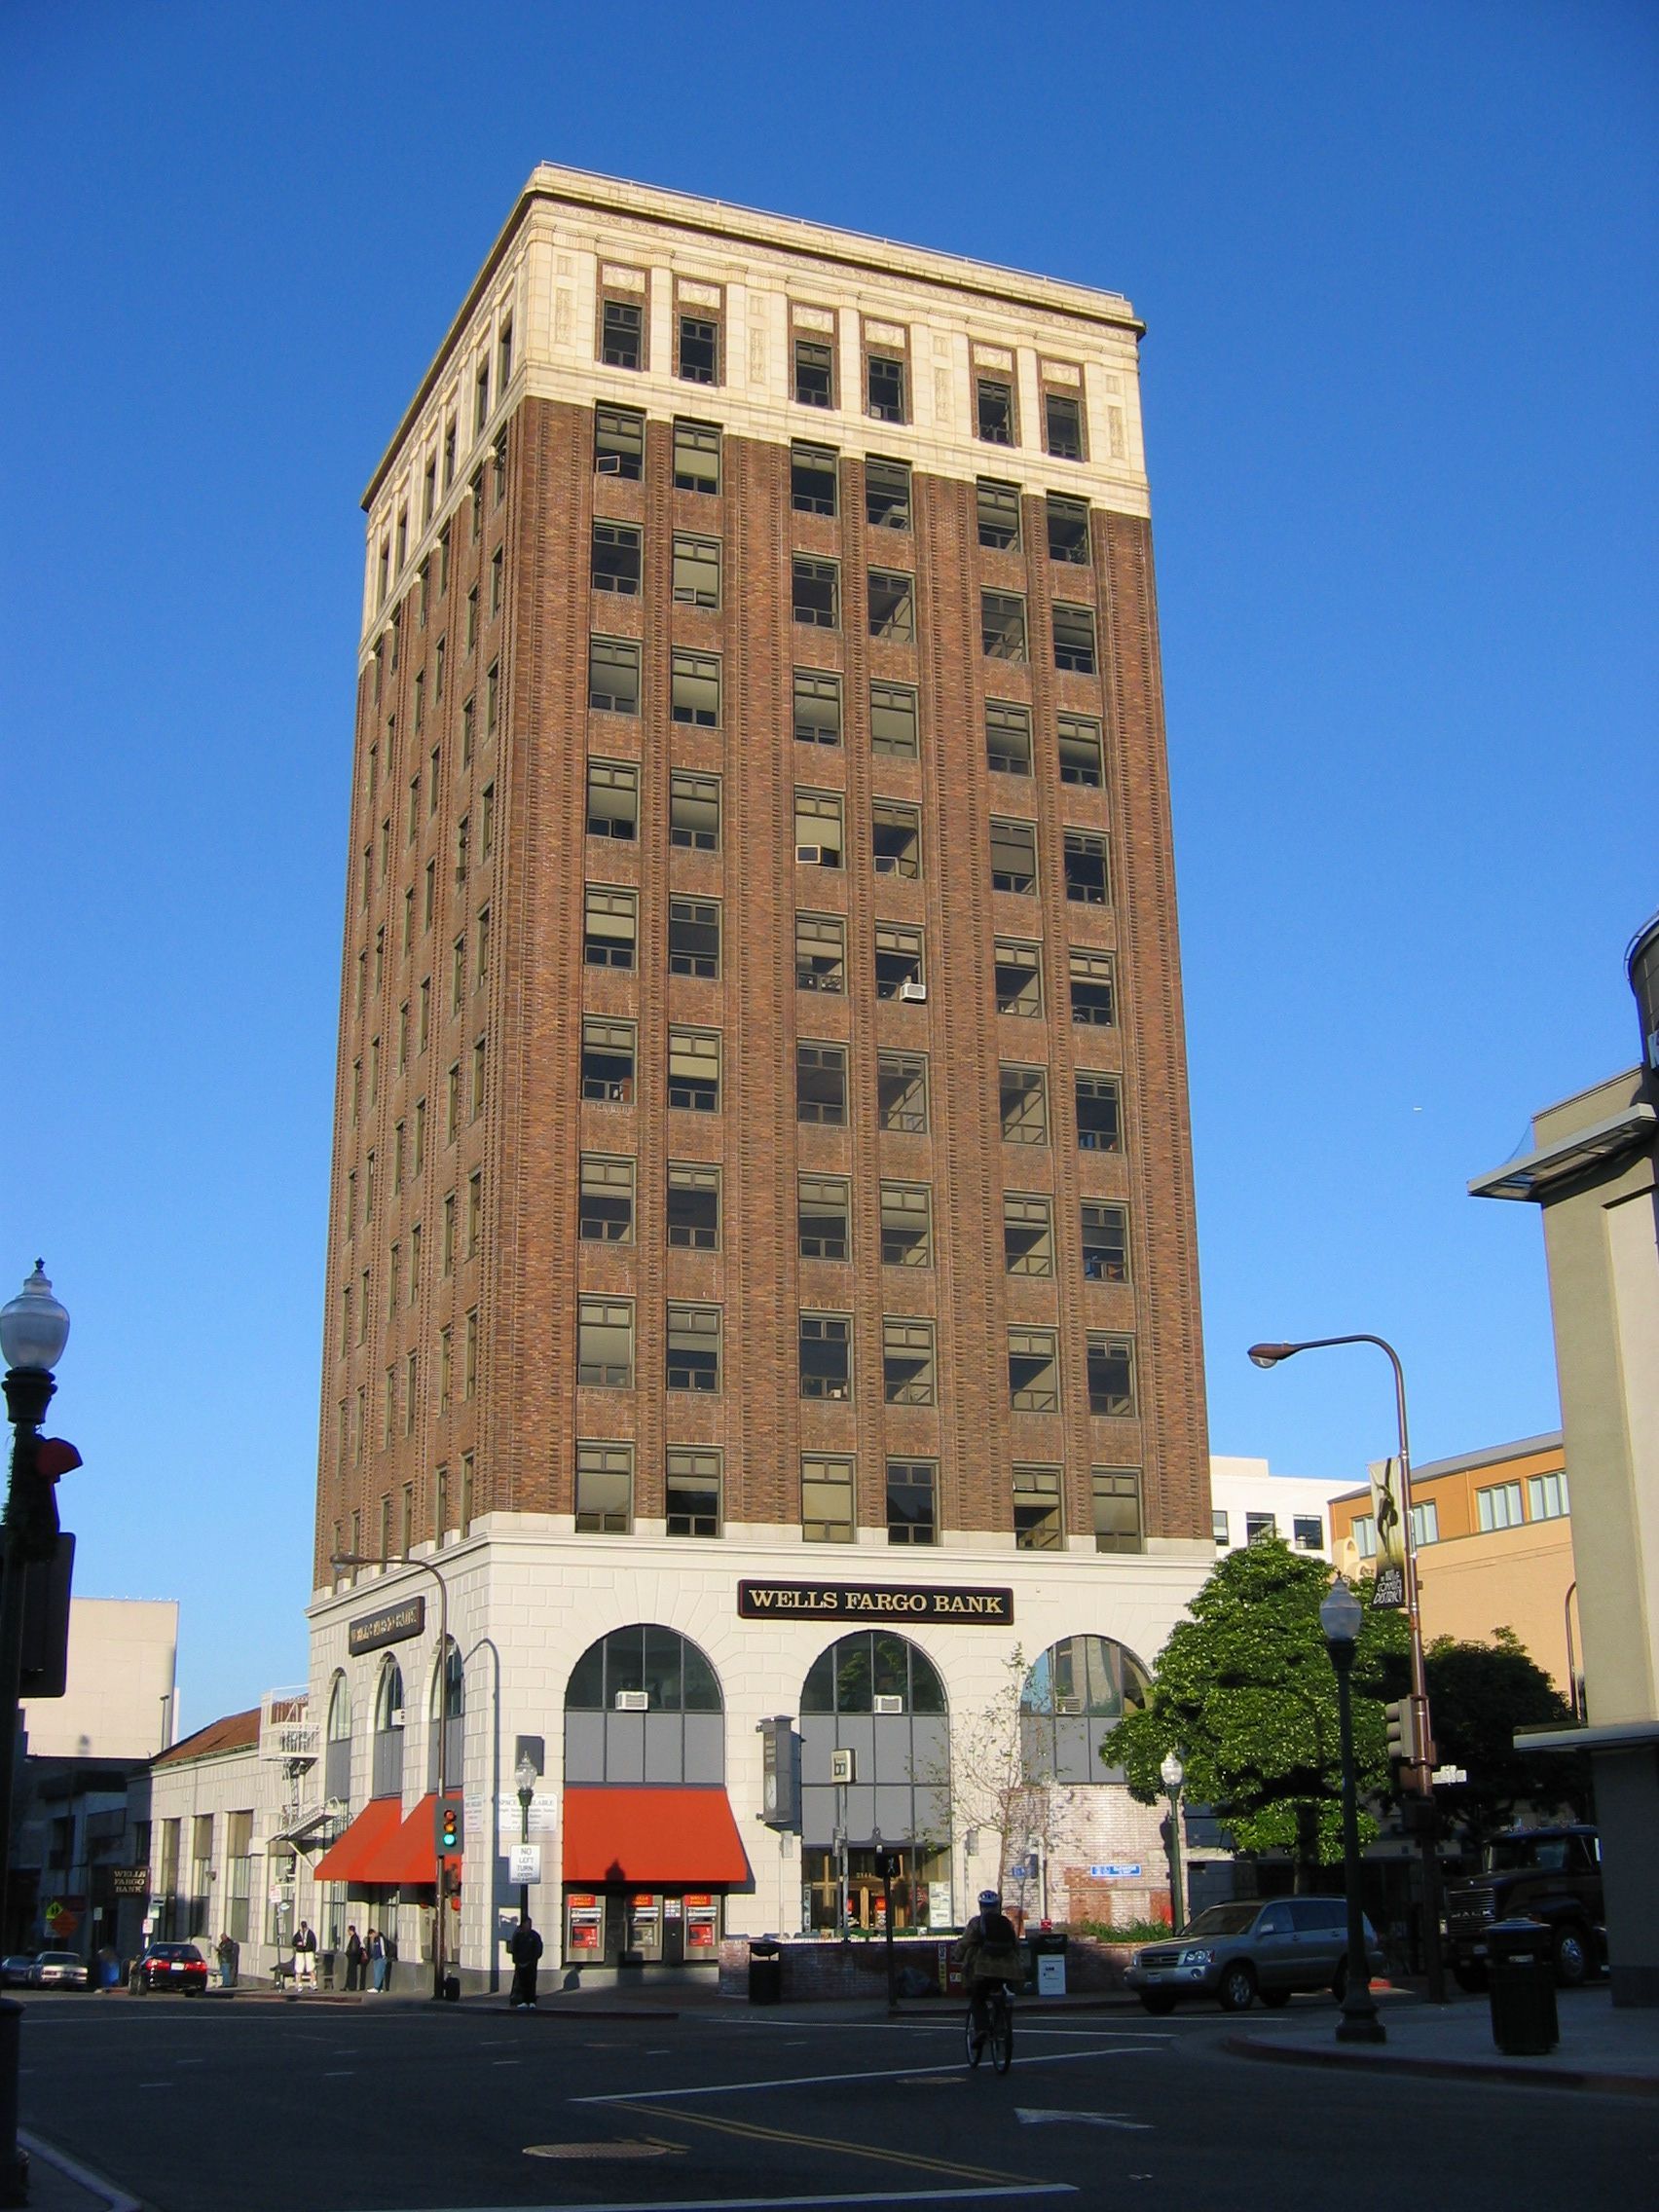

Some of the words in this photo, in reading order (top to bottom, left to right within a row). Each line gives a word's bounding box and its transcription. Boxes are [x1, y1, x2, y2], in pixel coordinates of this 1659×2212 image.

[748, 1589, 838, 1609] WELLS
[845, 1592, 927, 1611] FARGO
[933, 1595, 1004, 1614] BANK
